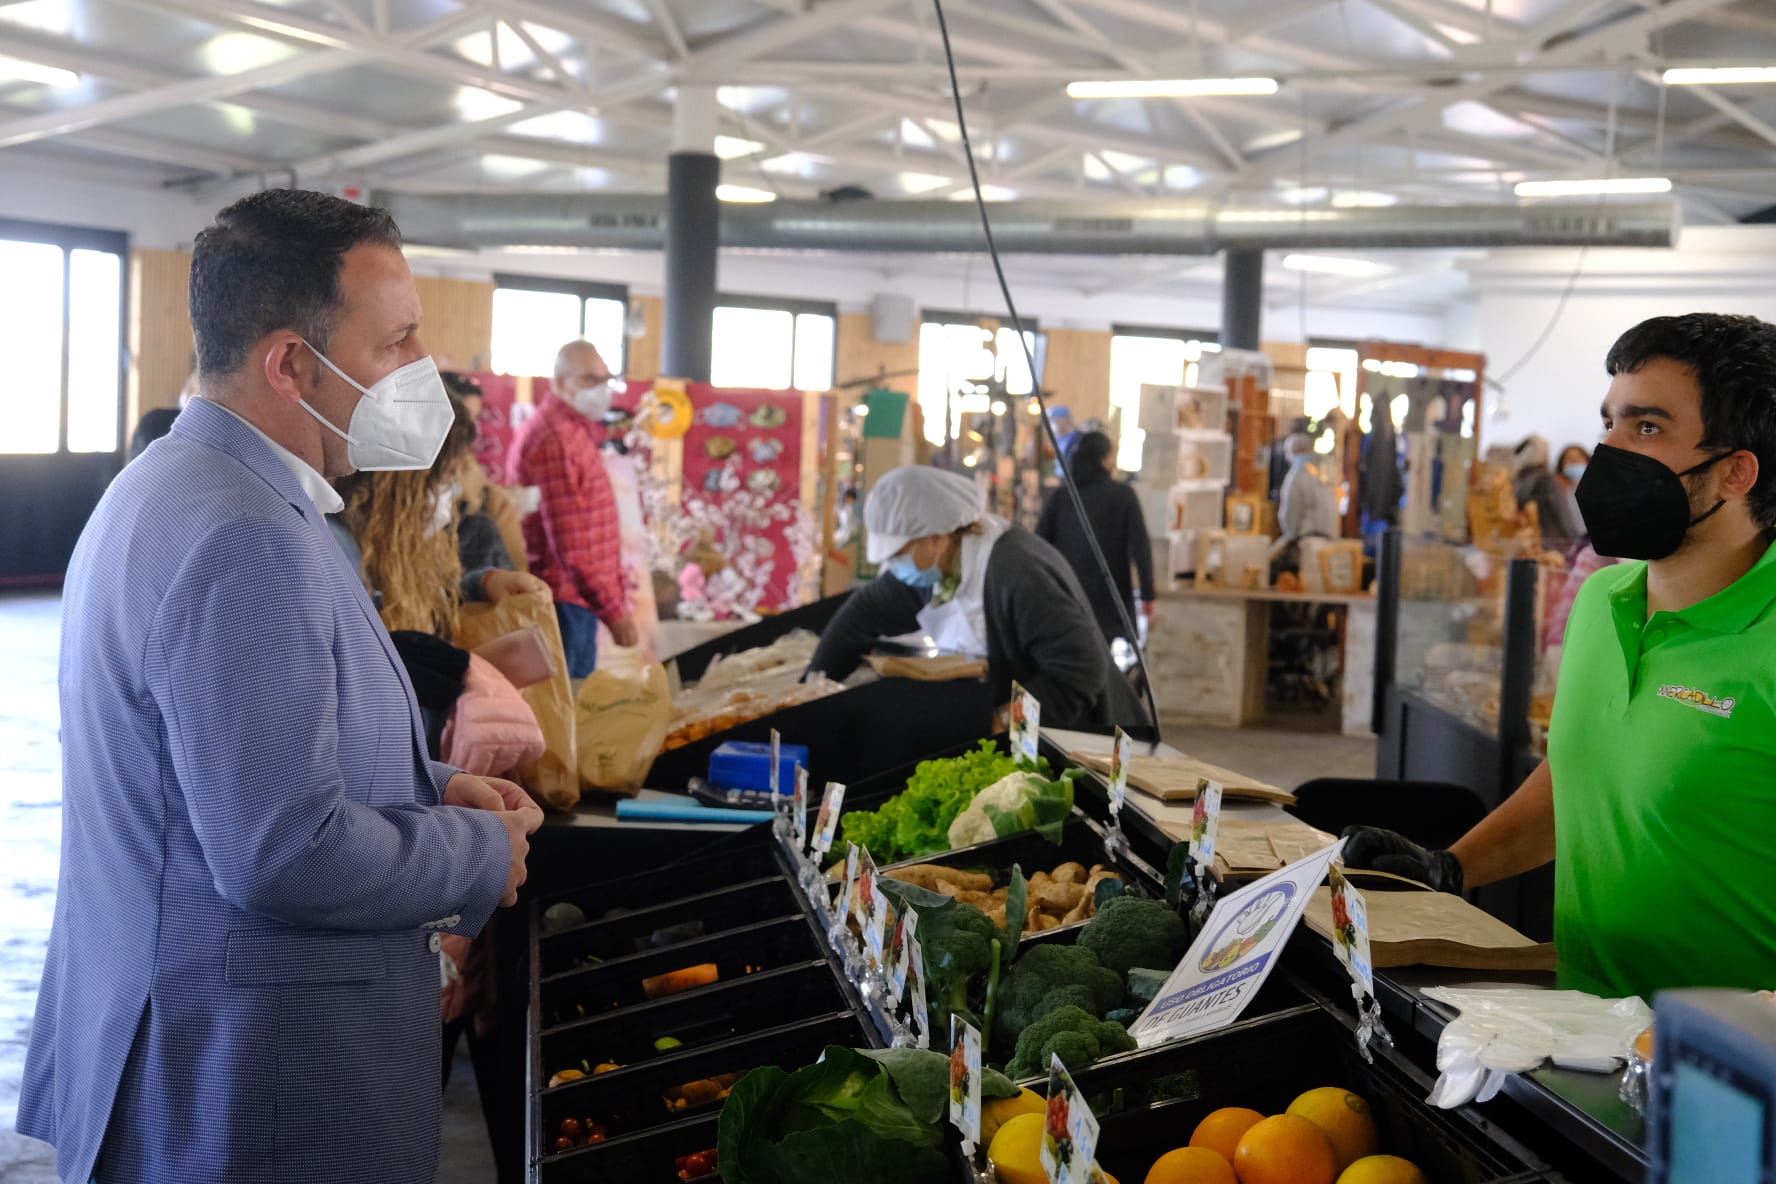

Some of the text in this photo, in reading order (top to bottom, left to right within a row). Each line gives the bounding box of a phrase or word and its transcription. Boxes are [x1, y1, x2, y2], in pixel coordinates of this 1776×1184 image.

[1186, 962, 1260, 998] OBLIGATORIO
[1141, 1011, 1171, 1033] DE
[1167, 983, 1246, 1024] GUANTES
